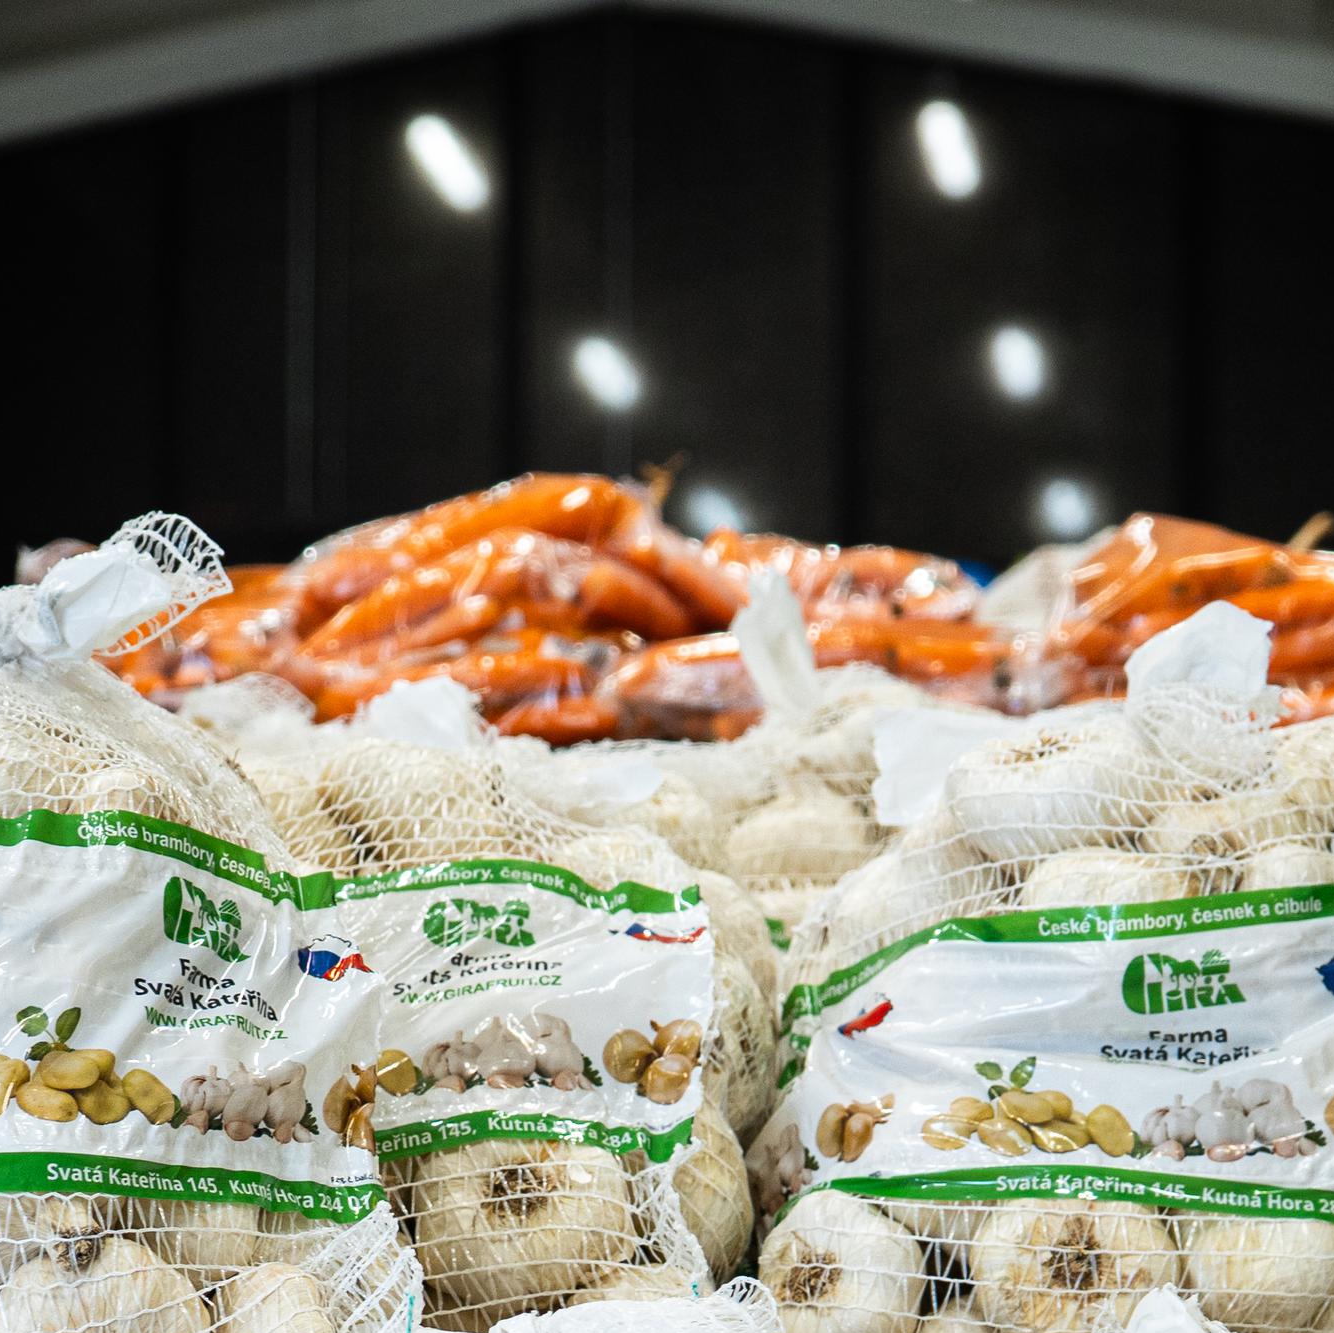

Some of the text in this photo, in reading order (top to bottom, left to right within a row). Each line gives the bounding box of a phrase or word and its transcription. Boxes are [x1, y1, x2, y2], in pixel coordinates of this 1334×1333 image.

[142, 826, 214, 867] brambory,
[500, 867, 565, 889] česnek
[1038, 896, 1322, 936] České brambory, česnek a cibule
[179, 958, 235, 989] Farma
[134, 978, 277, 1022] Svatá Kateřina
[376, 1132, 432, 1154] teřina
[439, 1121, 477, 1140] 145,
[488, 1116, 546, 1132] Kutná
[47, 1163, 102, 1184] Svatá
[108, 1168, 184, 1192] Kateřina
[229, 1179, 273, 1201] Kutná
[277, 1188, 314, 1209] Hora
[996, 1172, 1051, 1192] Svatá
[1057, 1174, 1145, 1196] Kateřina
[1202, 1187, 1261, 1209] Kutná
[1268, 1194, 1315, 1212] Hora
